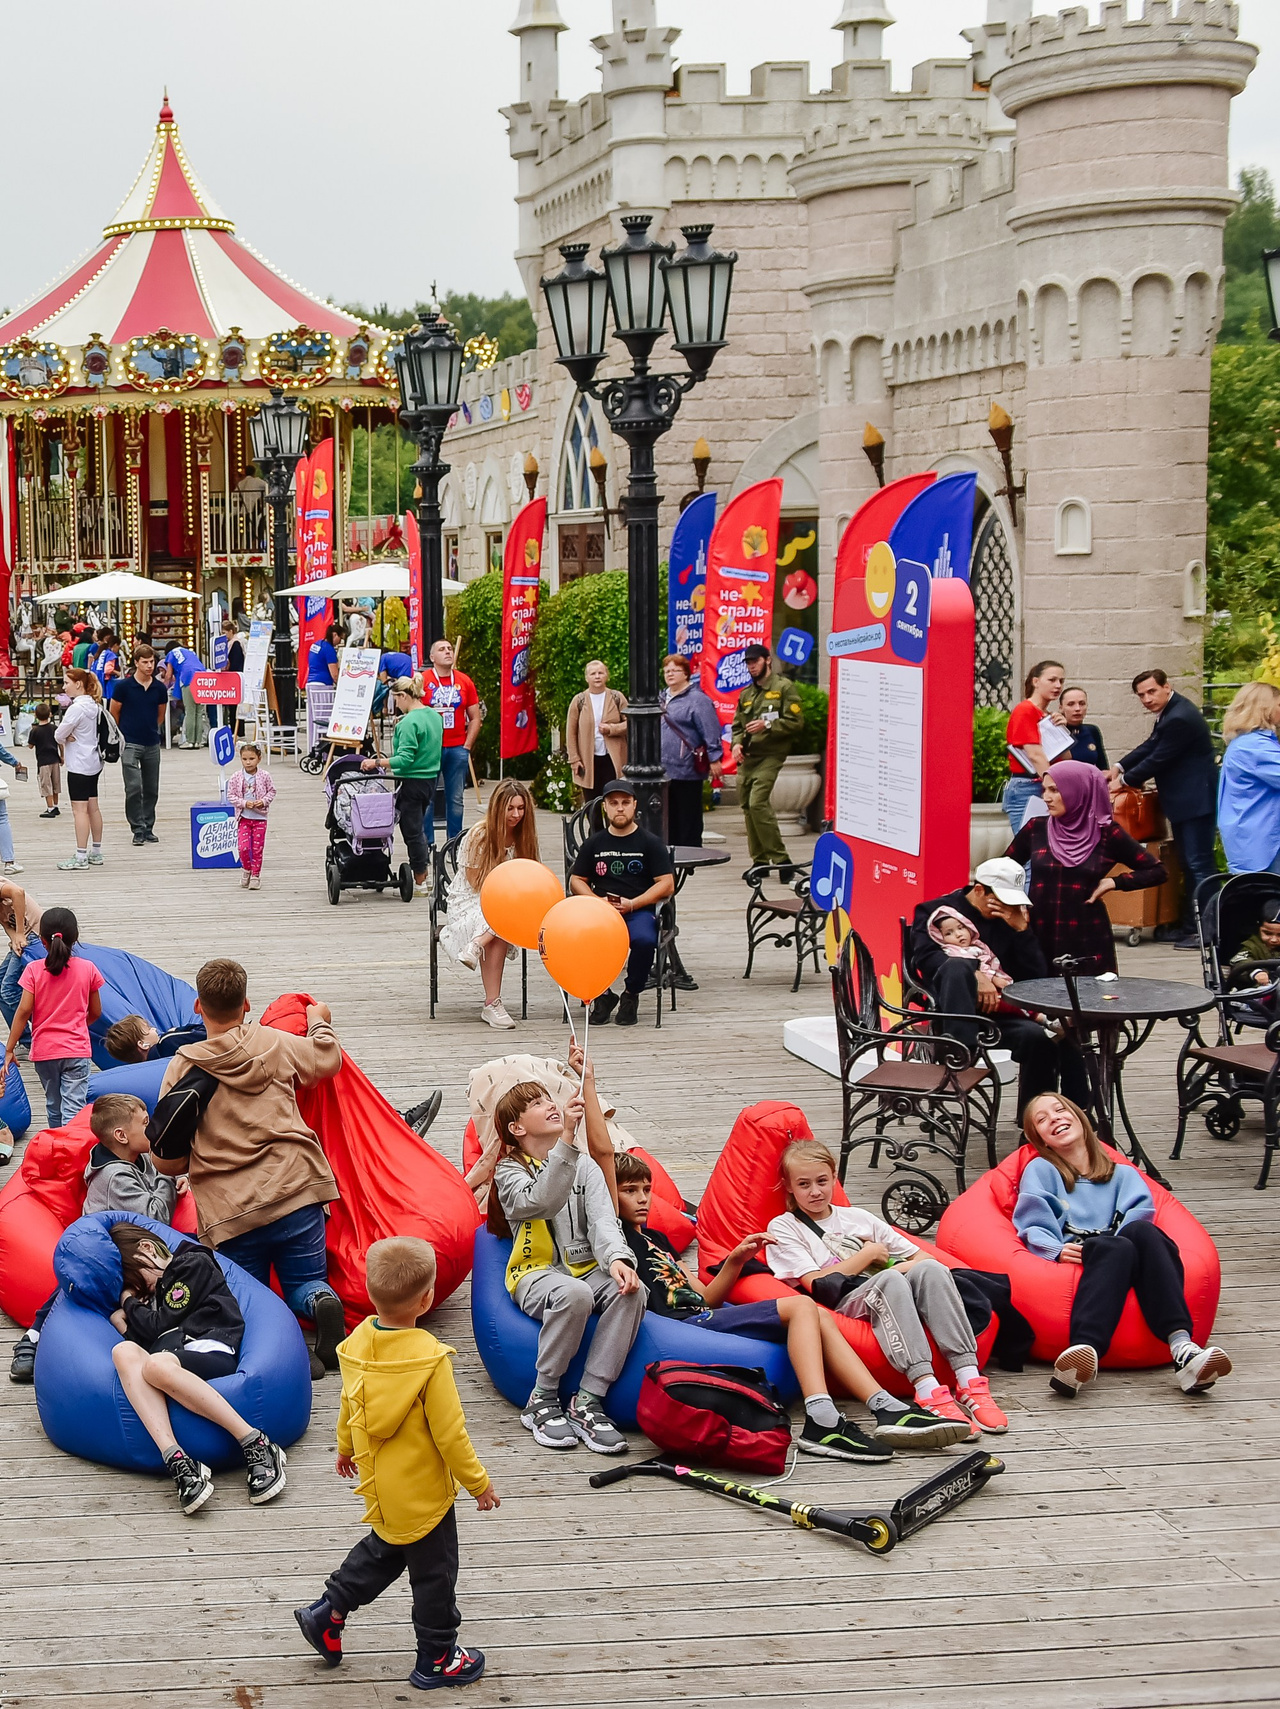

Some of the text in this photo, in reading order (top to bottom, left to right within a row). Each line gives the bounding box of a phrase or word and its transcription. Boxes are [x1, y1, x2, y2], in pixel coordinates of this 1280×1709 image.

[720, 589, 742, 602] не-
[904, 580, 918, 616] 2
[512, 607, 535, 620] спал
[718, 605, 769, 618] спаль-
[676, 613, 704, 625] спал
[896, 620, 923, 639] сентября
[719, 650, 746, 674] ДЕЛА
[196, 677, 217, 689] старт
[196, 686, 236, 700] экскурсий
[200, 839, 238, 853] НА РАЙОН
[523, 1221, 532, 1261] BLACK
[882, 1313, 893, 1330] BE
[889, 1330, 905, 1354] JUST
